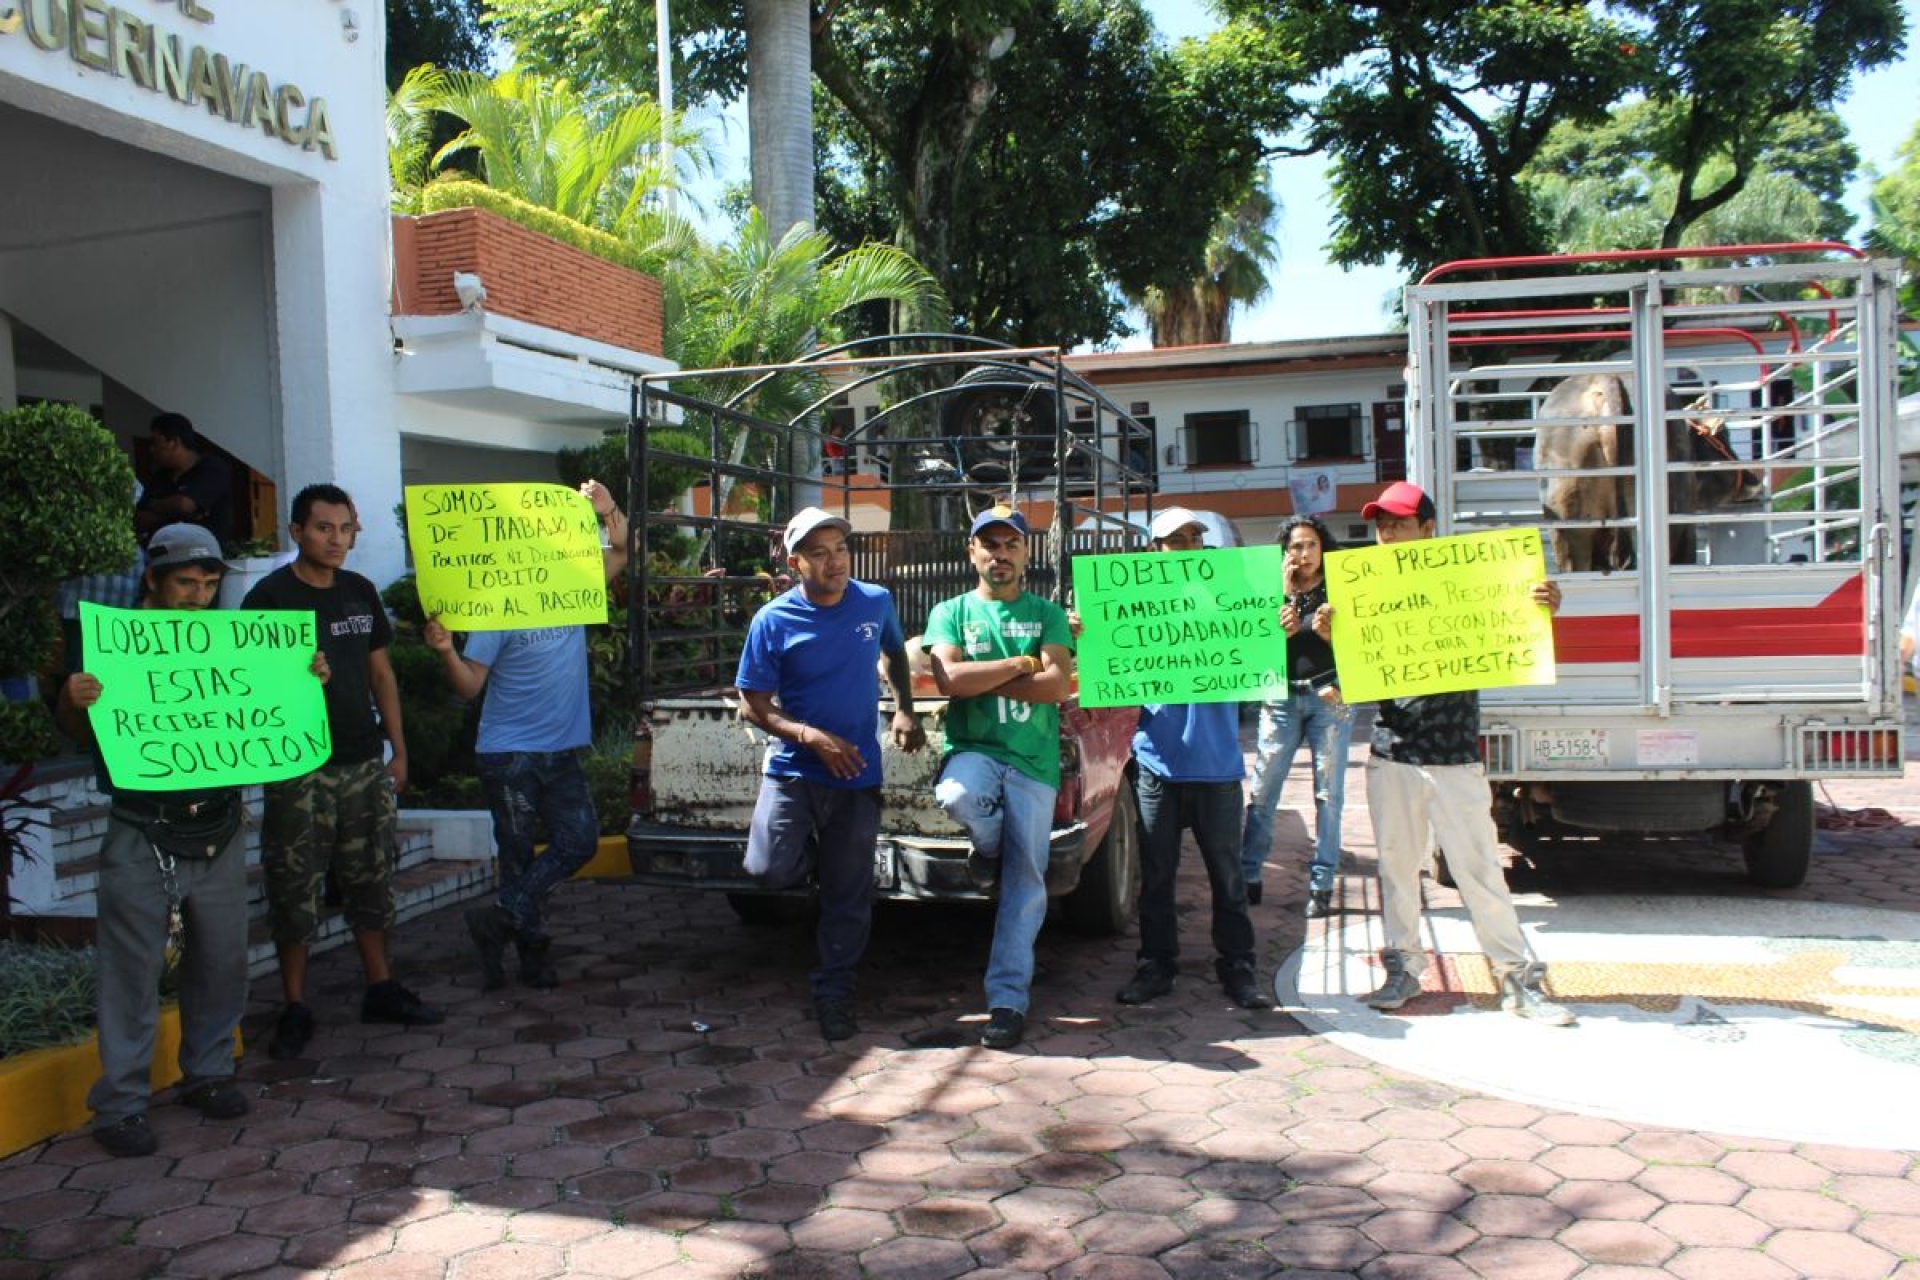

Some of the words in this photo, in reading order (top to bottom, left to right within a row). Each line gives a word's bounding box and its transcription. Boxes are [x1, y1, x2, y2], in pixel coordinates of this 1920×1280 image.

[0, 0, 338, 161] UERNAVACA
[423, 489, 497, 516] SOMOS
[521, 489, 579, 509] GENTE
[427, 524, 463, 545] DE
[507, 550, 524, 565] NI
[1394, 535, 1537, 575] PRESIDENTE
[468, 567, 549, 590] LOBITO
[1092, 558, 1215, 592] LOBITO
[503, 596, 528, 617] AL
[536, 588, 603, 613] RASTRO
[1092, 596, 1196, 622] TAMBIEN
[1215, 593, 1279, 612] SOMOS
[95, 613, 211, 655] LOBITO
[230, 613, 315, 650] DÓNDE
[1111, 617, 1271, 649] CIUDADANOS
[1361, 622, 1383, 646] NO
[1392, 619, 1421, 638] TE
[1428, 608, 1527, 635] ESCONDAS
[1476, 632, 1486, 649] Y
[1107, 648, 1243, 676] ESCUCHANOS
[1379, 649, 1536, 687] RESPUESTAS
[147, 667, 252, 705] ESTAS
[1096, 680, 1174, 701] RASTRO
[1192, 665, 1285, 694] SOLUCION
[112, 706, 286, 738] RECIBENOS
[139, 719, 328, 778] SOLUCION
